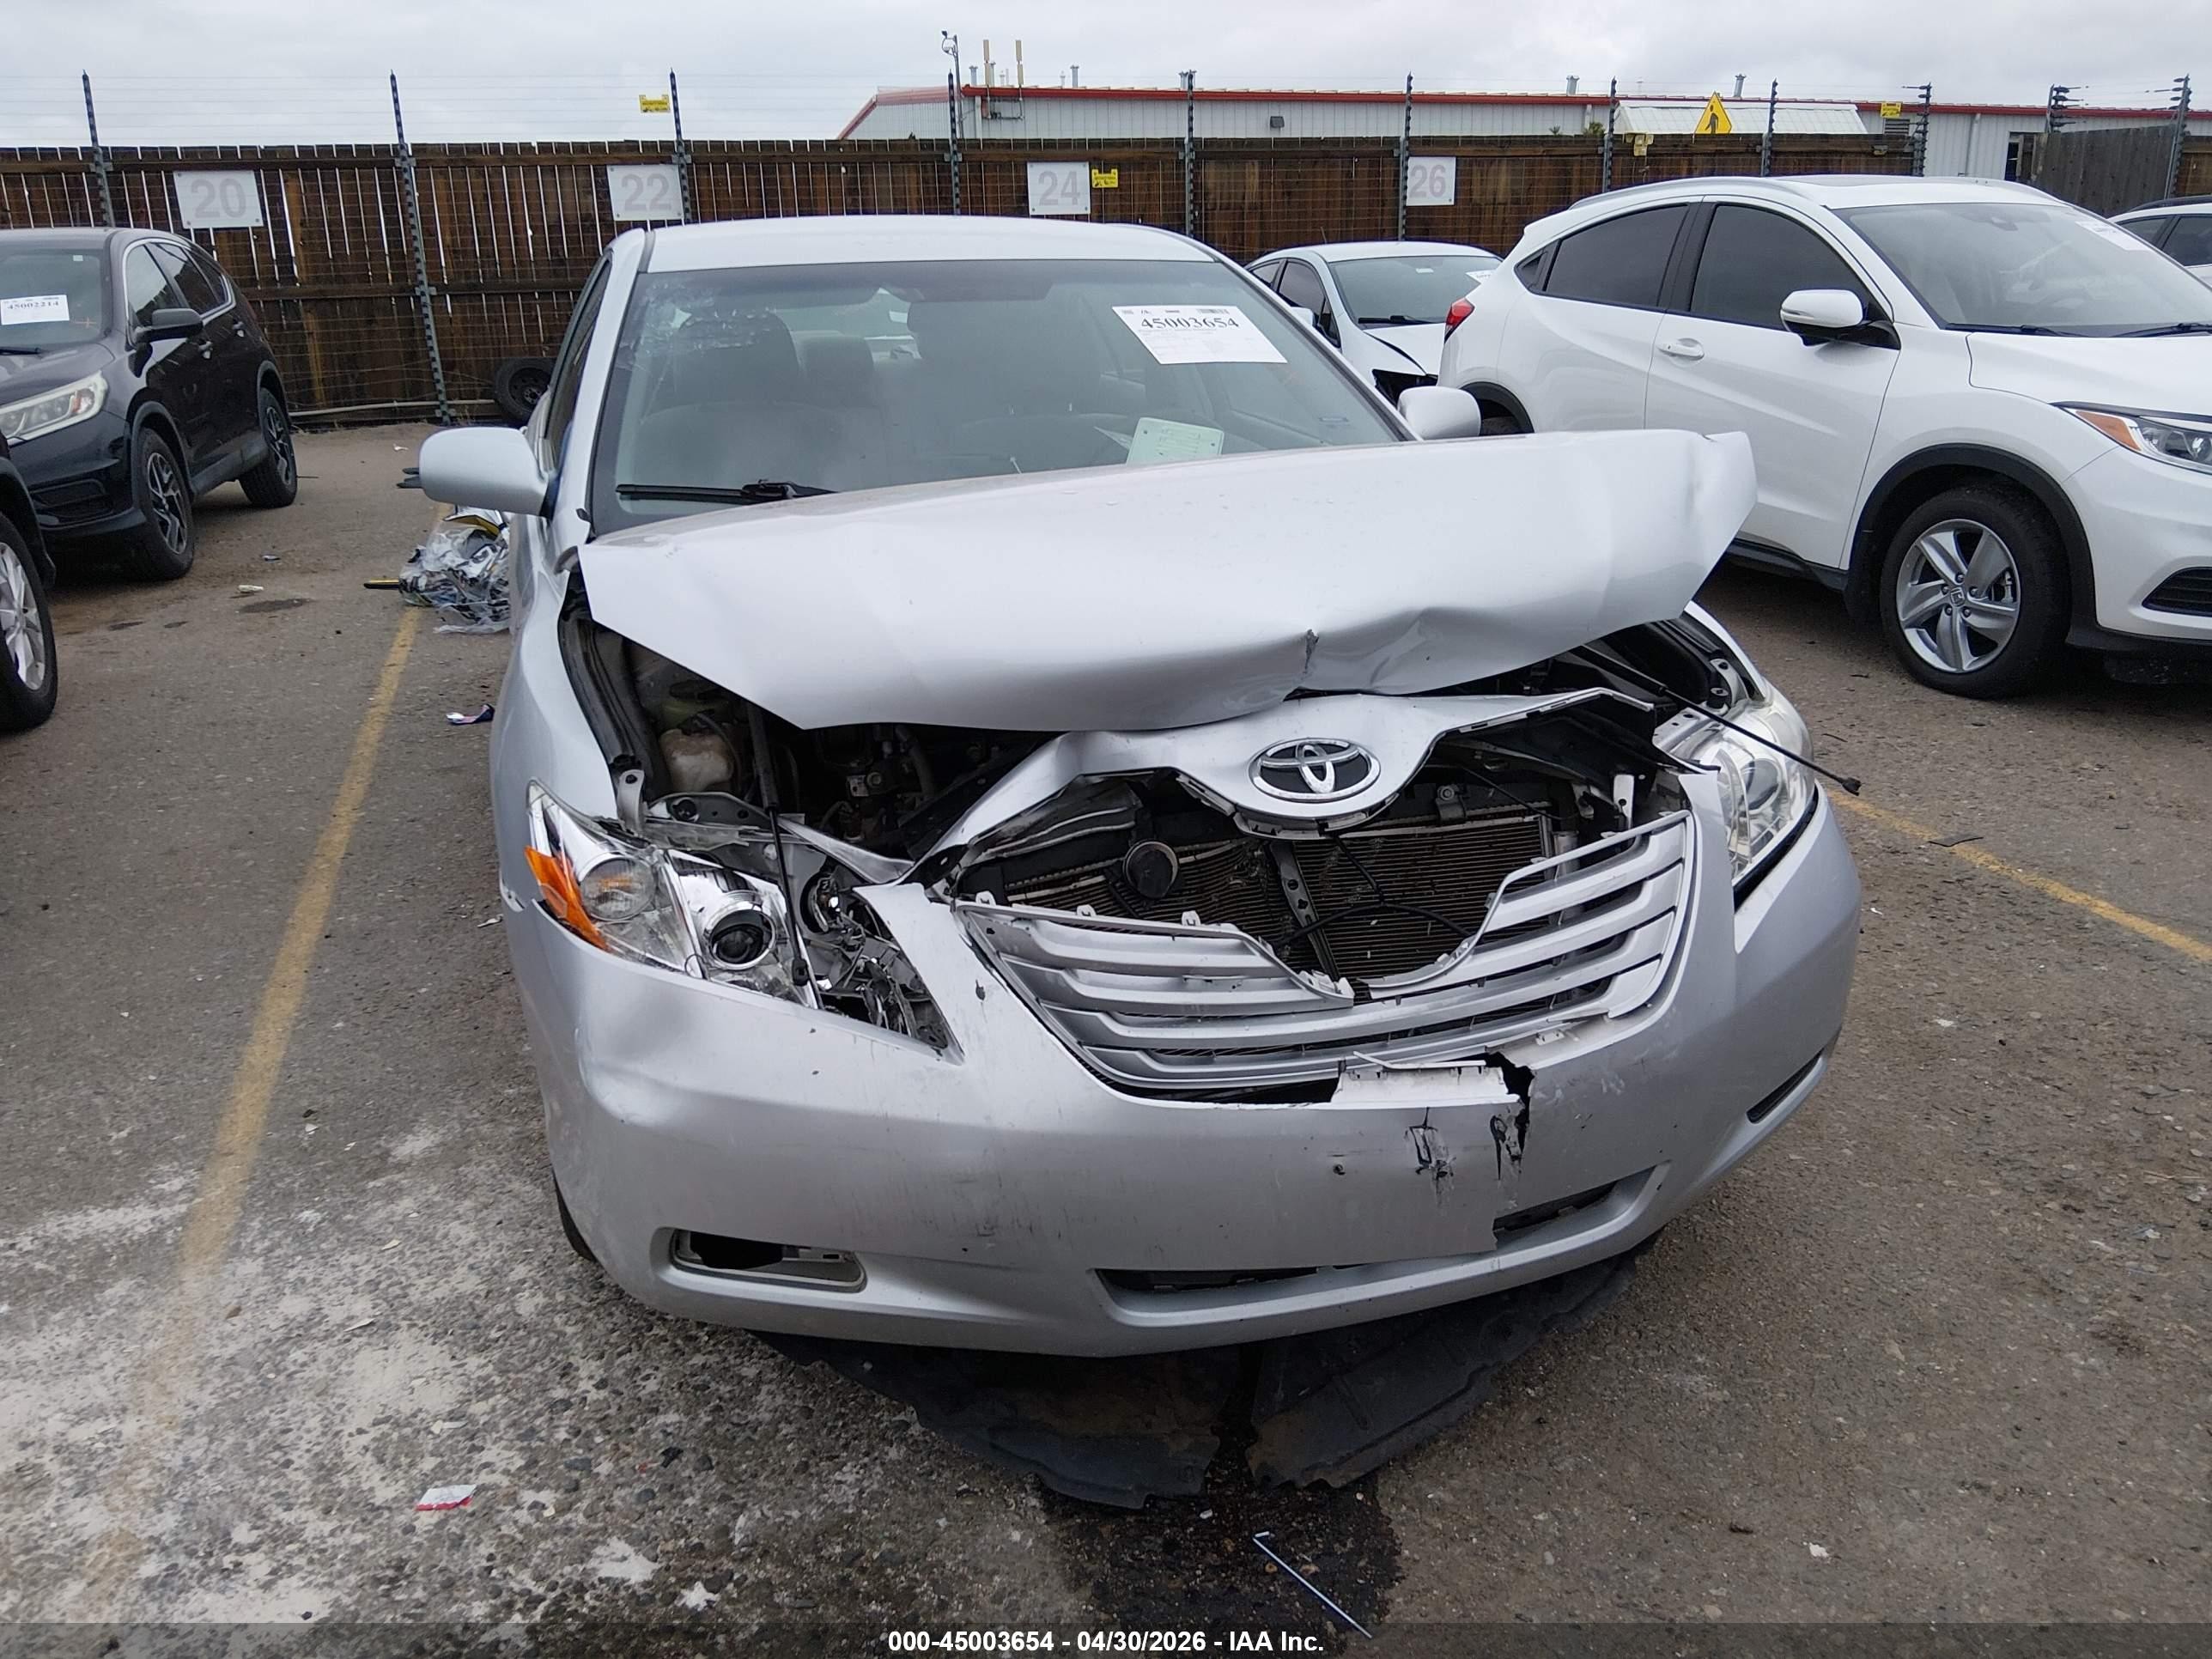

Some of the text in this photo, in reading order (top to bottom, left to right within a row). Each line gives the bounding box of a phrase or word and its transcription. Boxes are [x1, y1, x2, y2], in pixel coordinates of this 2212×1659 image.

[191, 178, 246, 218] 20
[622, 173, 672, 211] 22
[1038, 171, 1080, 205] 24
[1409, 165, 1446, 198] 26
[1140, 317, 1239, 329] 45003654
